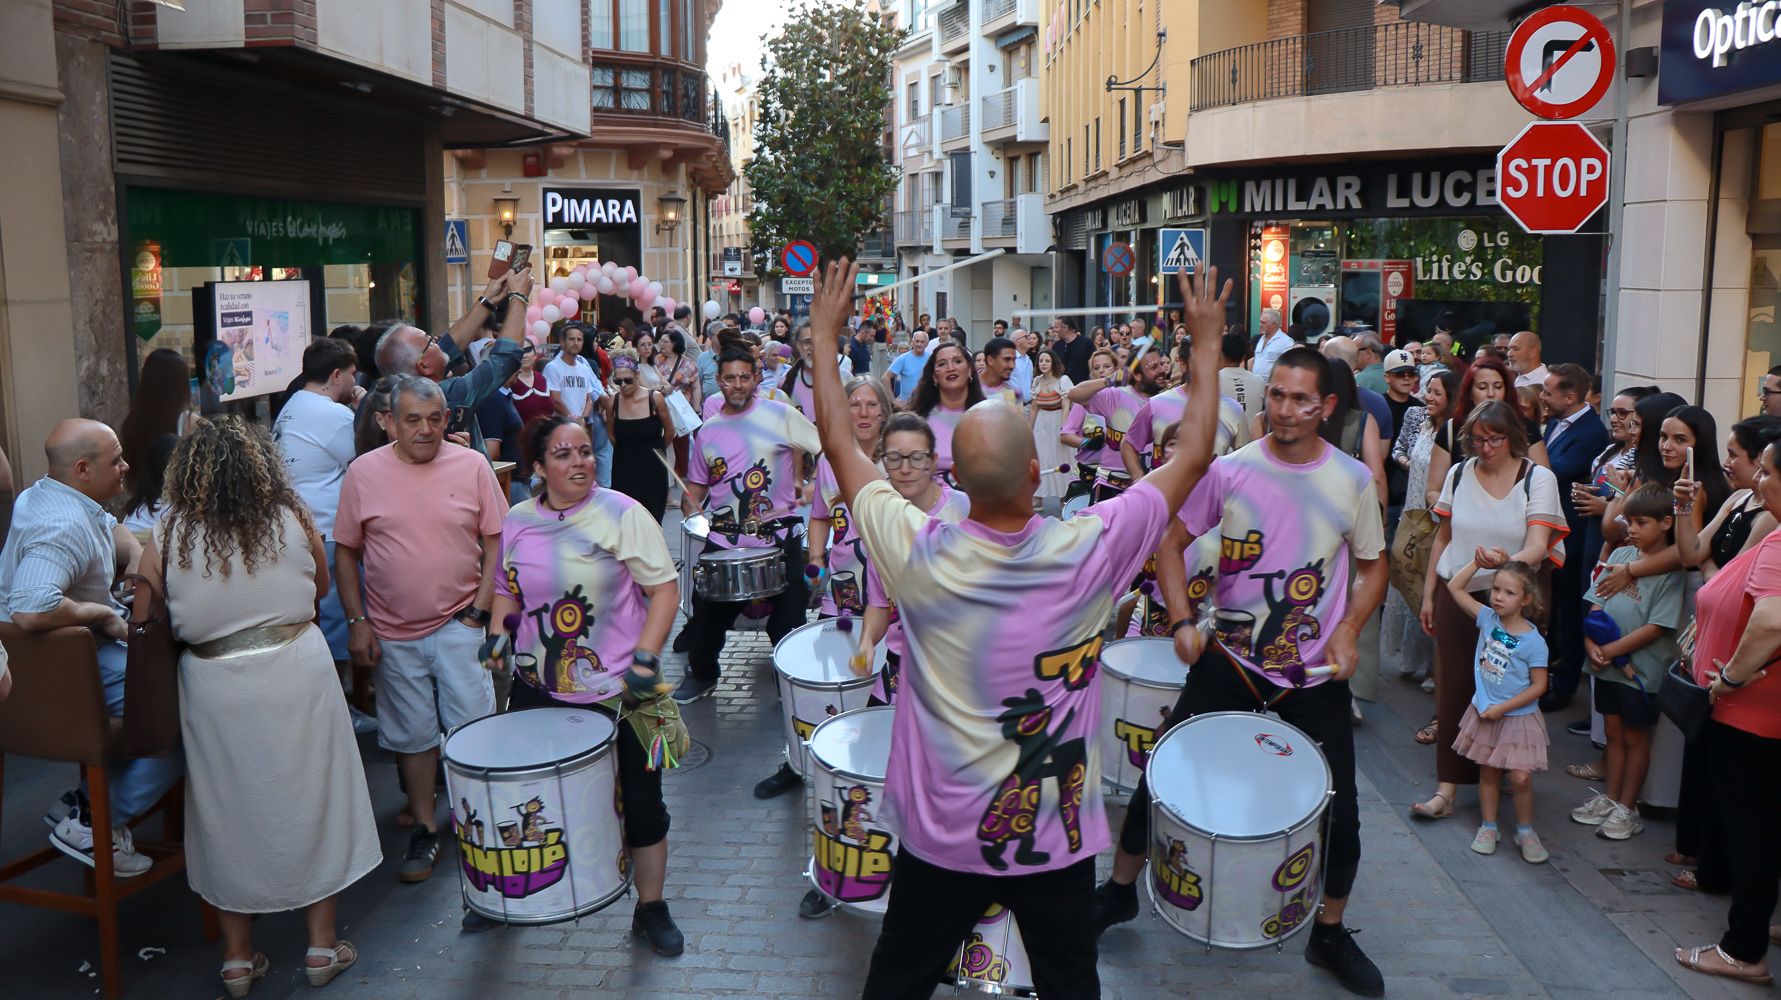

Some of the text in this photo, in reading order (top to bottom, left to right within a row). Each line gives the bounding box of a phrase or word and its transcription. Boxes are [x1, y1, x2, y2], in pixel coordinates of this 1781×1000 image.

[1245, 168, 1497, 213] MILAR LUCE
[1506, 157, 1602, 198] STOP
[546, 191, 637, 224] PIMARA
[1162, 185, 1195, 220] MILAR
[246, 220, 284, 239] VIAJES
[1484, 231, 1510, 247] LG
[1416, 254, 1543, 285] Life's Goo
[220, 303, 240, 311] realidad
[236, 292, 252, 300] verano
